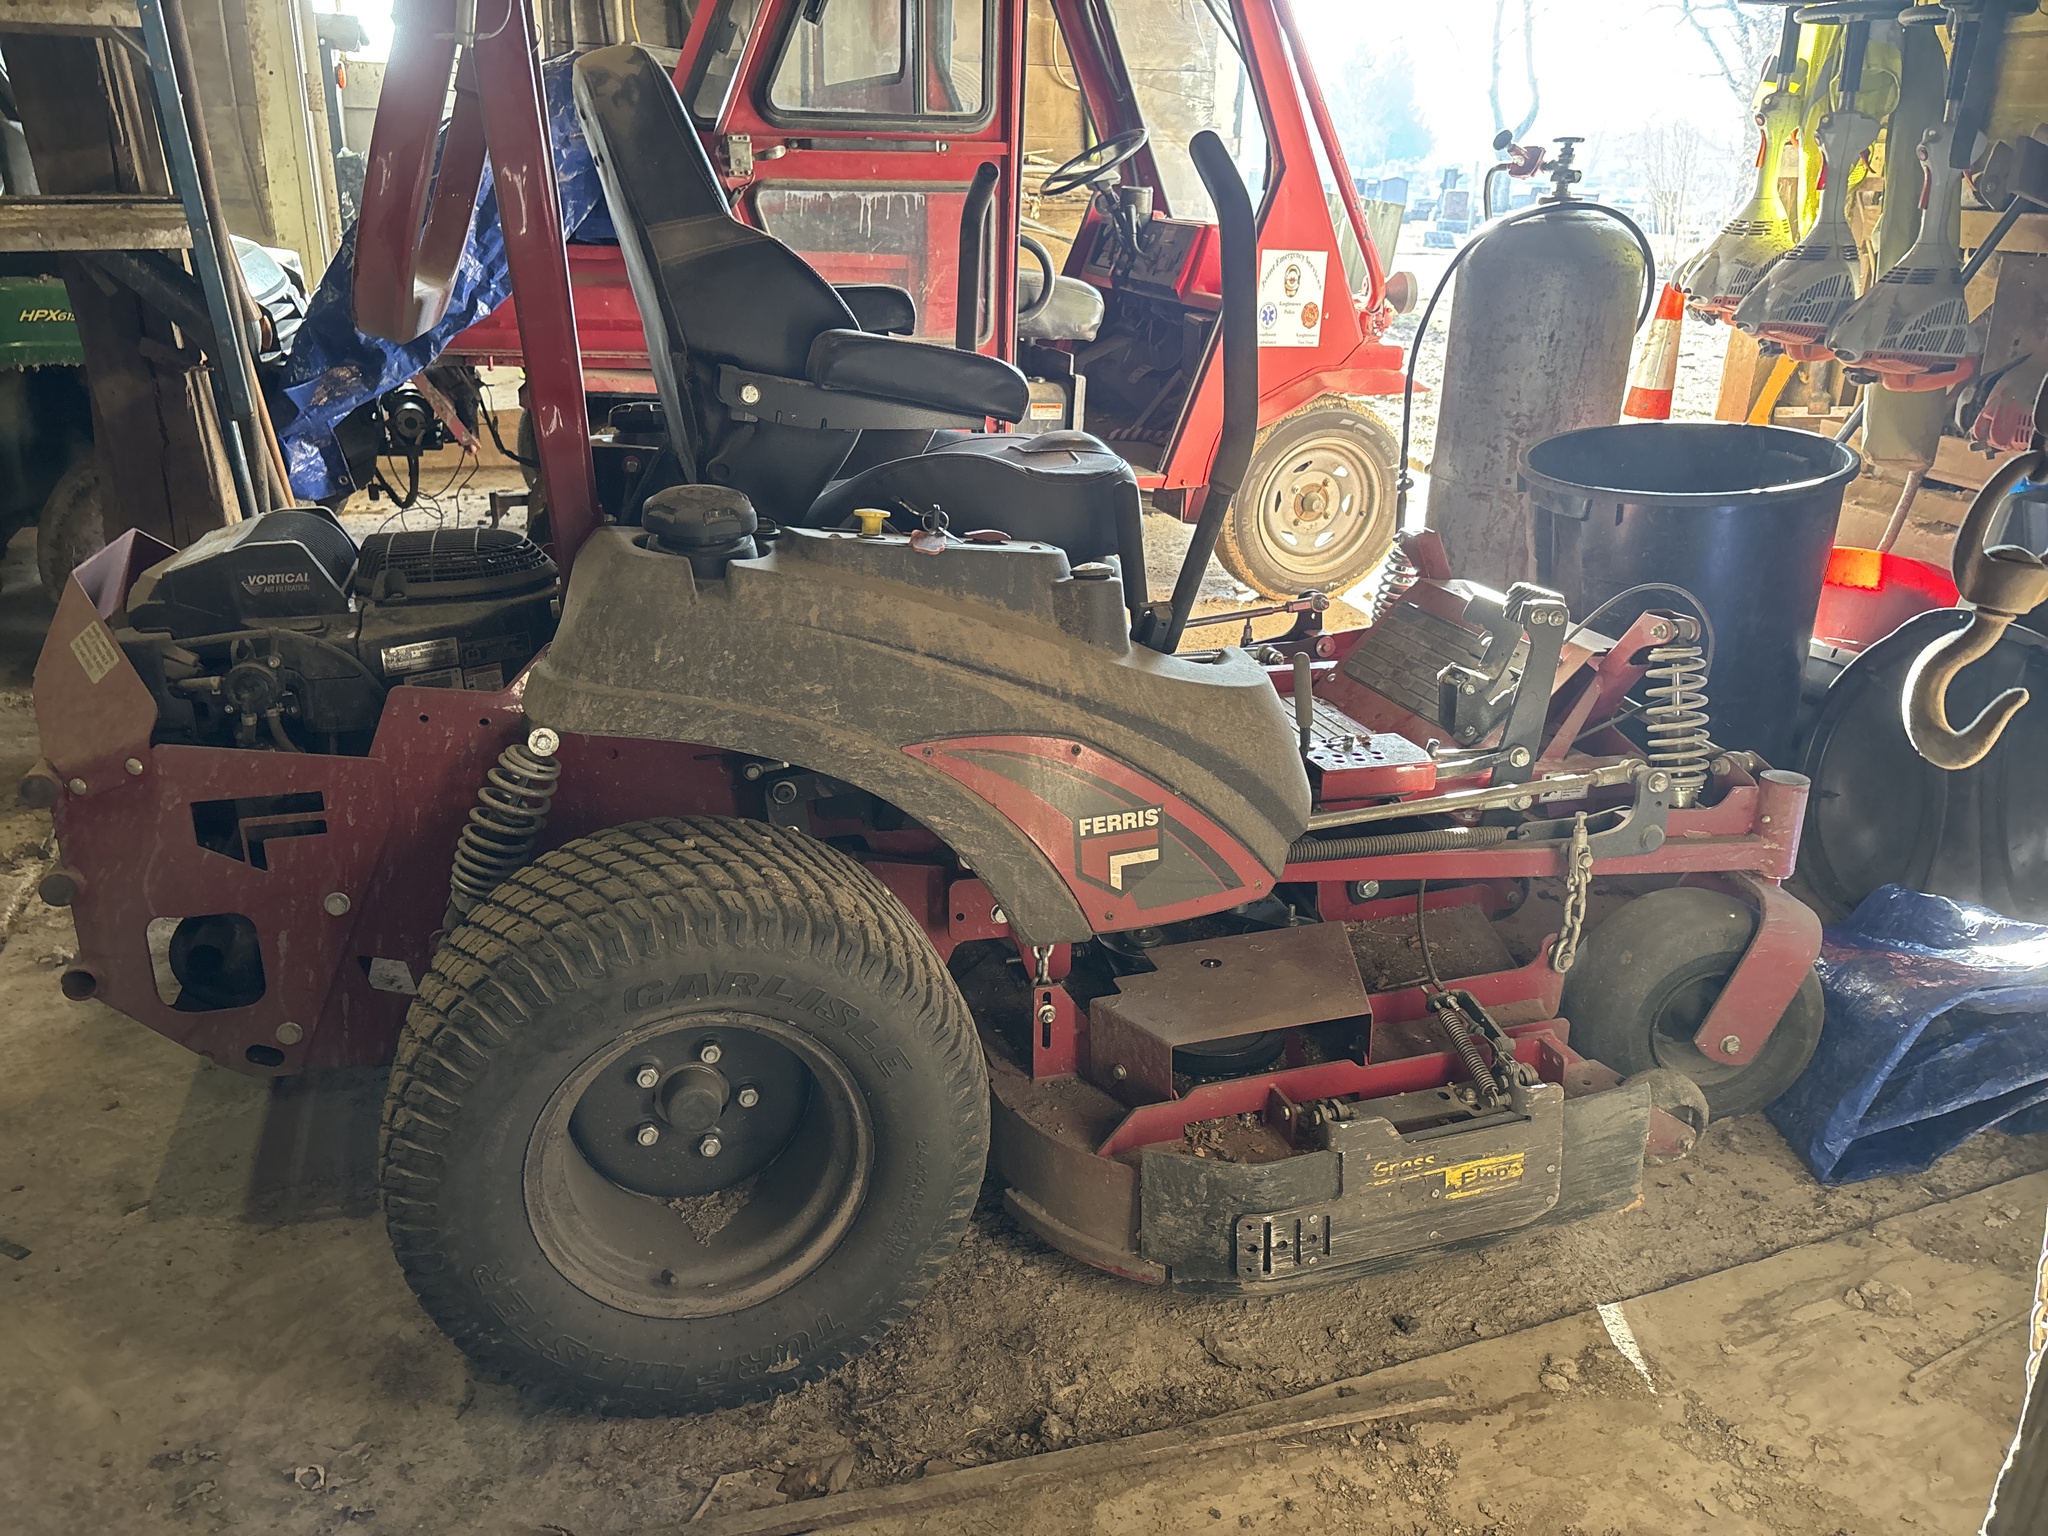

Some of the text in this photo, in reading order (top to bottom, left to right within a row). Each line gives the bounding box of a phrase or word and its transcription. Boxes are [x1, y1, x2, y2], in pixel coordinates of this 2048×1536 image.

[1275, 252, 1305, 267] Emergency
[247, 572, 310, 586] VORTICAL
[1079, 808, 1160, 837] FERRIS
[623, 969, 915, 1079] CARLISLE
[1372, 1154, 1436, 1178] Grass
